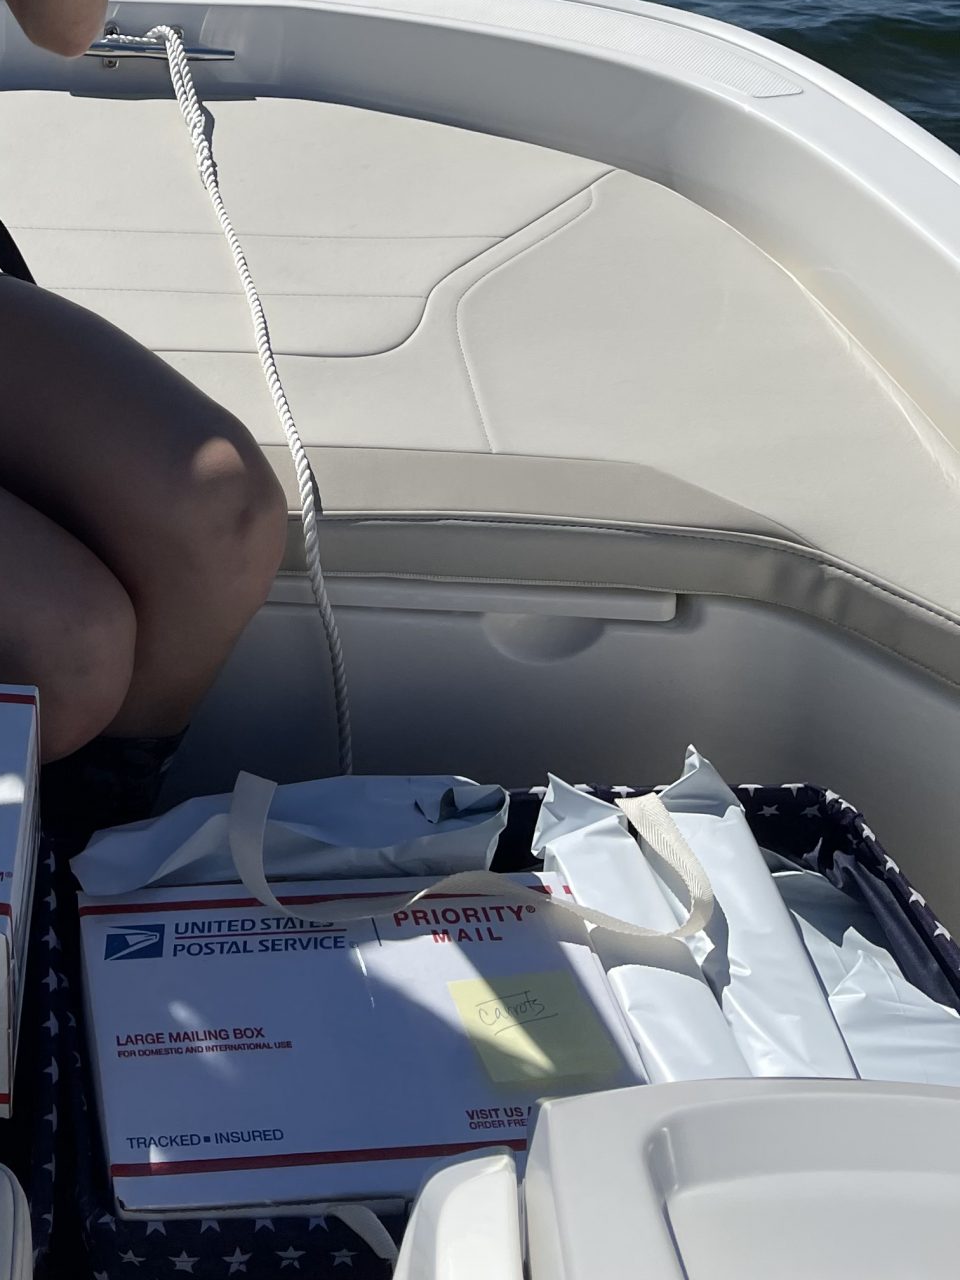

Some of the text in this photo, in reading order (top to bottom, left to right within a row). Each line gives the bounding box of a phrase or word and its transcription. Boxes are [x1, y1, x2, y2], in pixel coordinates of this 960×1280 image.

[174, 918, 256, 935] UNITED
[430, 926, 503, 944] MAIL
[173, 940, 254, 957] POSTAL
[115, 1026, 266, 1047] LARGE MAILING BOX
[117, 1039, 293, 1059] FOR DOMESTIC AND INTERNATIONAL USE
[464, 1107, 501, 1121] VISIT
[503, 1106, 524, 1119] US
[469, 1118, 529, 1130] ORDER FRE
[126, 1128, 285, 1150] TRACKED INSURED
